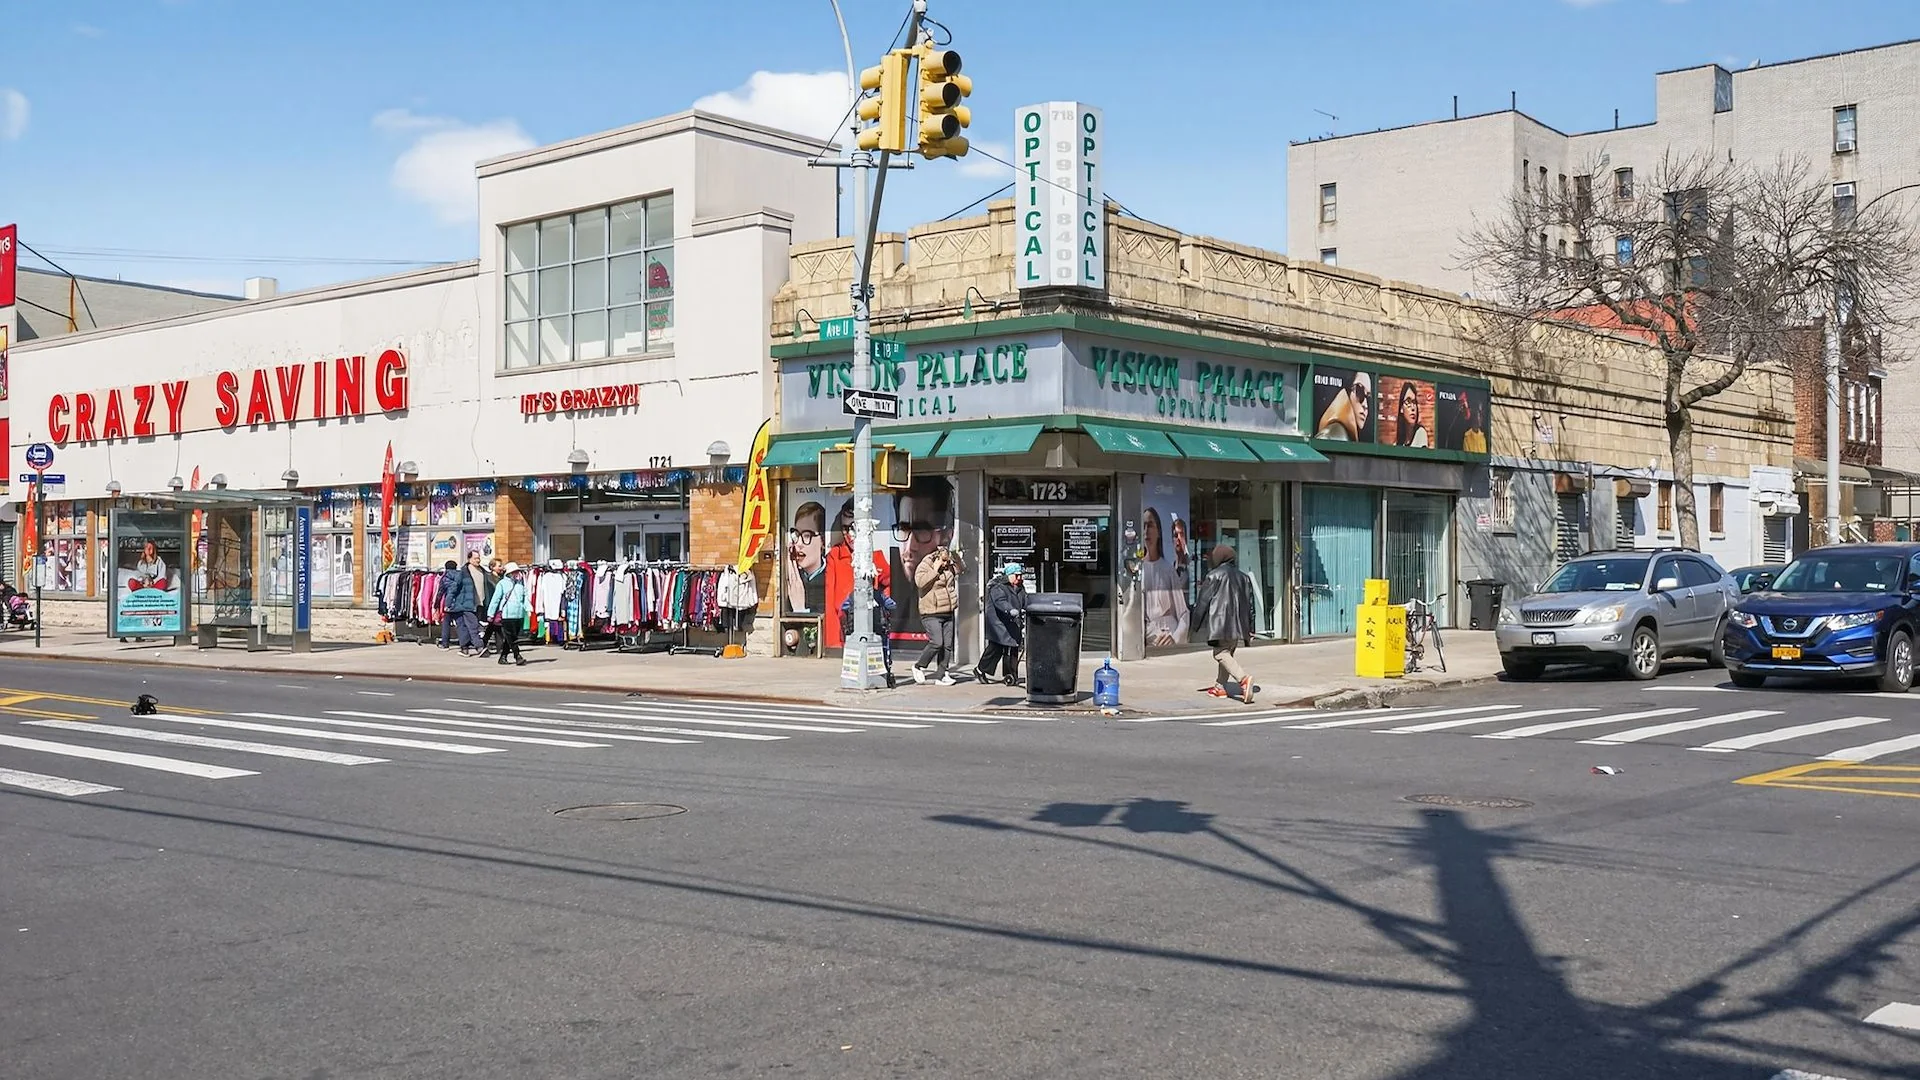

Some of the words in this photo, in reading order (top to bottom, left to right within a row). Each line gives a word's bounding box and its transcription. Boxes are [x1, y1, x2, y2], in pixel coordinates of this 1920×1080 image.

[1052, 110, 1074, 121] 718
[1023, 112, 1042, 281] OPTICAL
[1083, 112, 1097, 281] OPTICAL
[826, 323, 841, 338] Ave
[843, 321, 849, 335] U
[874, 342, 880, 357] E
[883, 344, 892, 358] 18
[807, 358, 899, 399] VISON
[917, 342, 1028, 389] PALACE
[1091, 347, 1179, 391] VISION
[1197, 361, 1284, 404] PALACE
[49, 381, 188, 443] CRAZY
[216, 349, 409, 429] SAVING
[520, 392, 557, 414] IT'S
[560, 384, 640, 410] CRAZY!!
[851, 397, 867, 408] ONE
[874, 400, 891, 411] WAY
[898, 395, 957, 418] TICAL
[1158, 395, 1227, 423] OPTICAL
[649, 456, 672, 469] 1721
[1030, 482, 1067, 501] 1723
